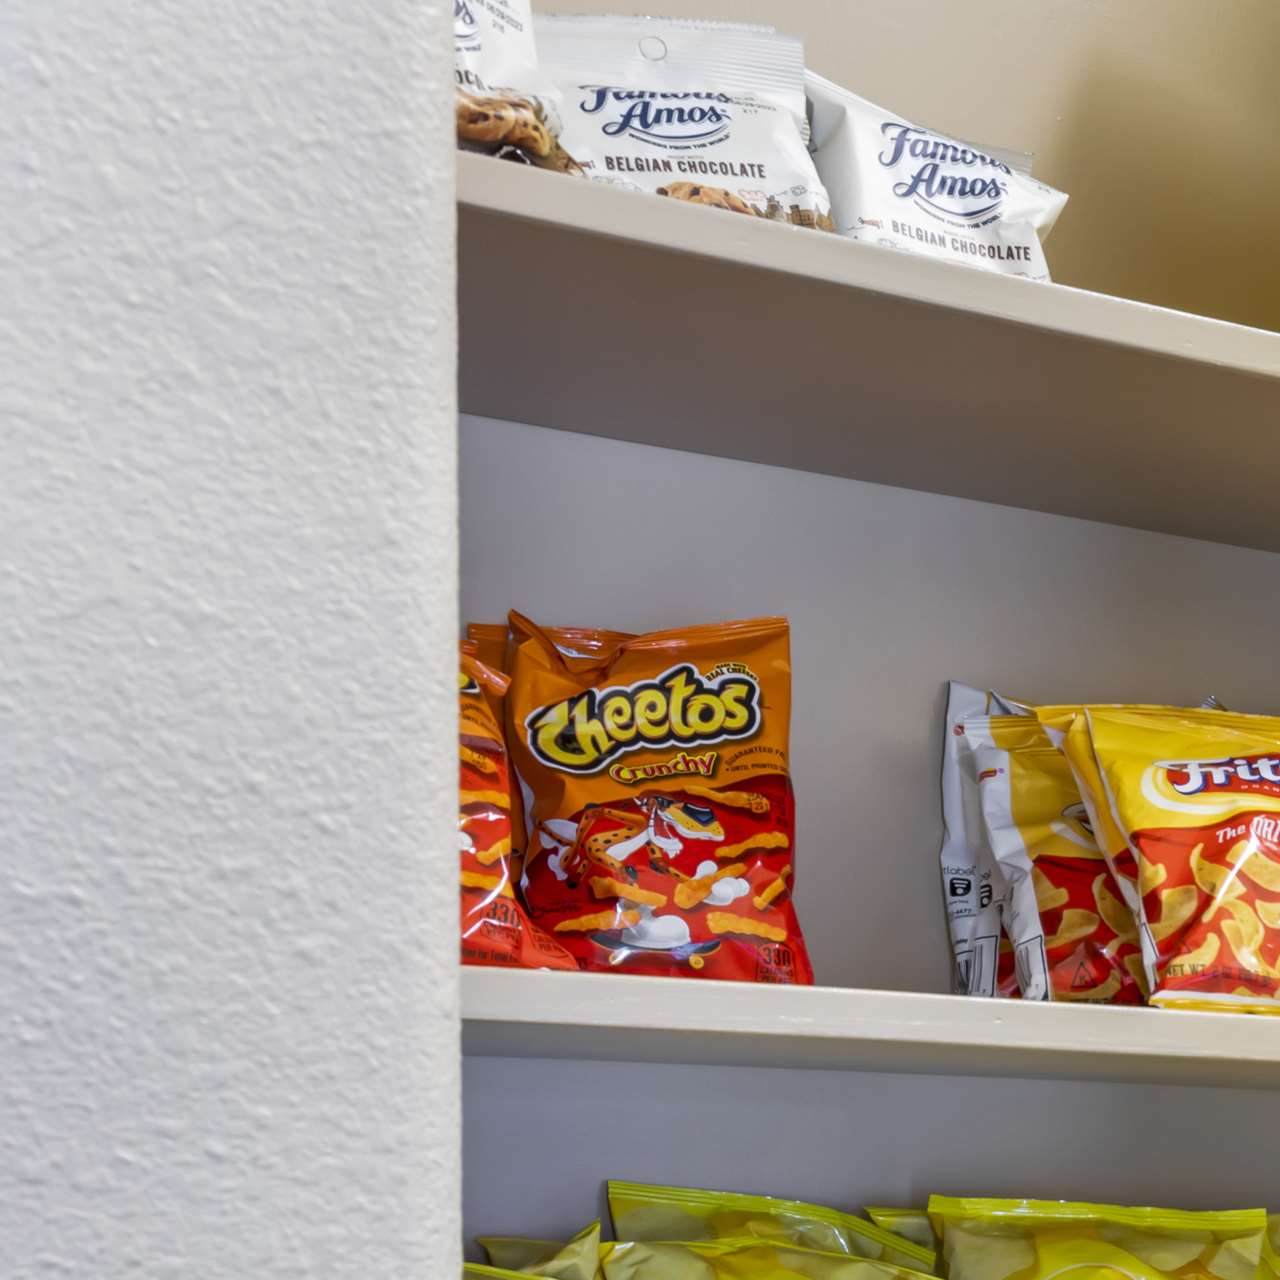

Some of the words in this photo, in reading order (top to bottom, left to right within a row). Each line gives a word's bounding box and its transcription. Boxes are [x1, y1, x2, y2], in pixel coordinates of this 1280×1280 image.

[602, 101, 724, 136] Amos
[605, 156, 673, 172] BELGIAN
[677, 160, 767, 178] CHOCOLATE
[893, 162, 1001, 198] Amos
[892, 221, 946, 248] BELGIAN
[951, 238, 1031, 261] CHOCOLATE
[532, 665, 752, 769] Cheetos
[609, 750, 717, 785] Crunchy
[1216, 824, 1247, 844] The
